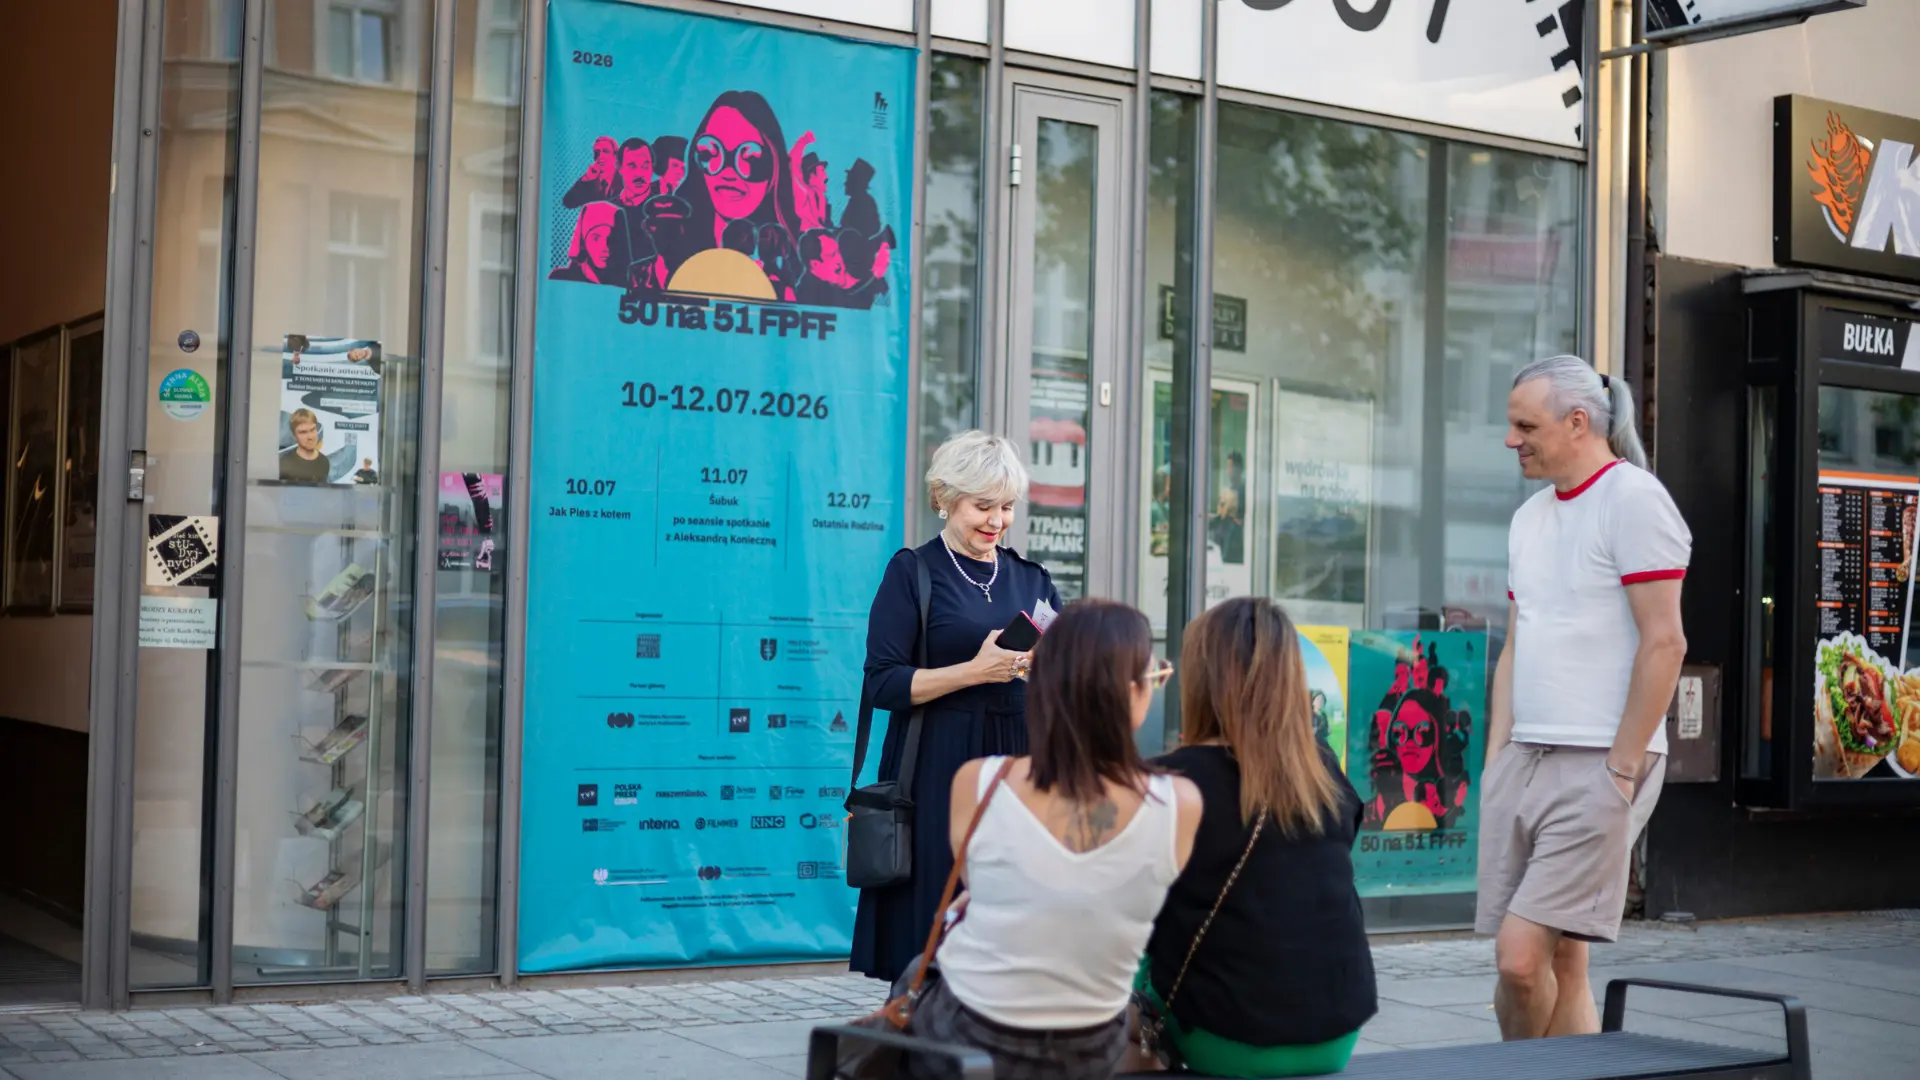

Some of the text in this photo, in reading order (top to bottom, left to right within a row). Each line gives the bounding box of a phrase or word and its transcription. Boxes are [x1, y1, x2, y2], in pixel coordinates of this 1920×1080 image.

[572, 50, 614, 68] 2026
[618, 299, 838, 341] 50 na 51 FPFF
[1842, 322, 1895, 356] BUŁKA
[621, 381, 829, 420] 10-12.07.2026
[701, 467, 748, 485] 11.07
[566, 477, 616, 496] 10.07
[827, 491, 871, 509] 12.07
[549, 507, 566, 519] Jak
[601, 509, 631, 520] kotem
[673, 517, 771, 530] po seansie spotkanie
[1360, 831, 1467, 853] 50 na 51 FPFF
